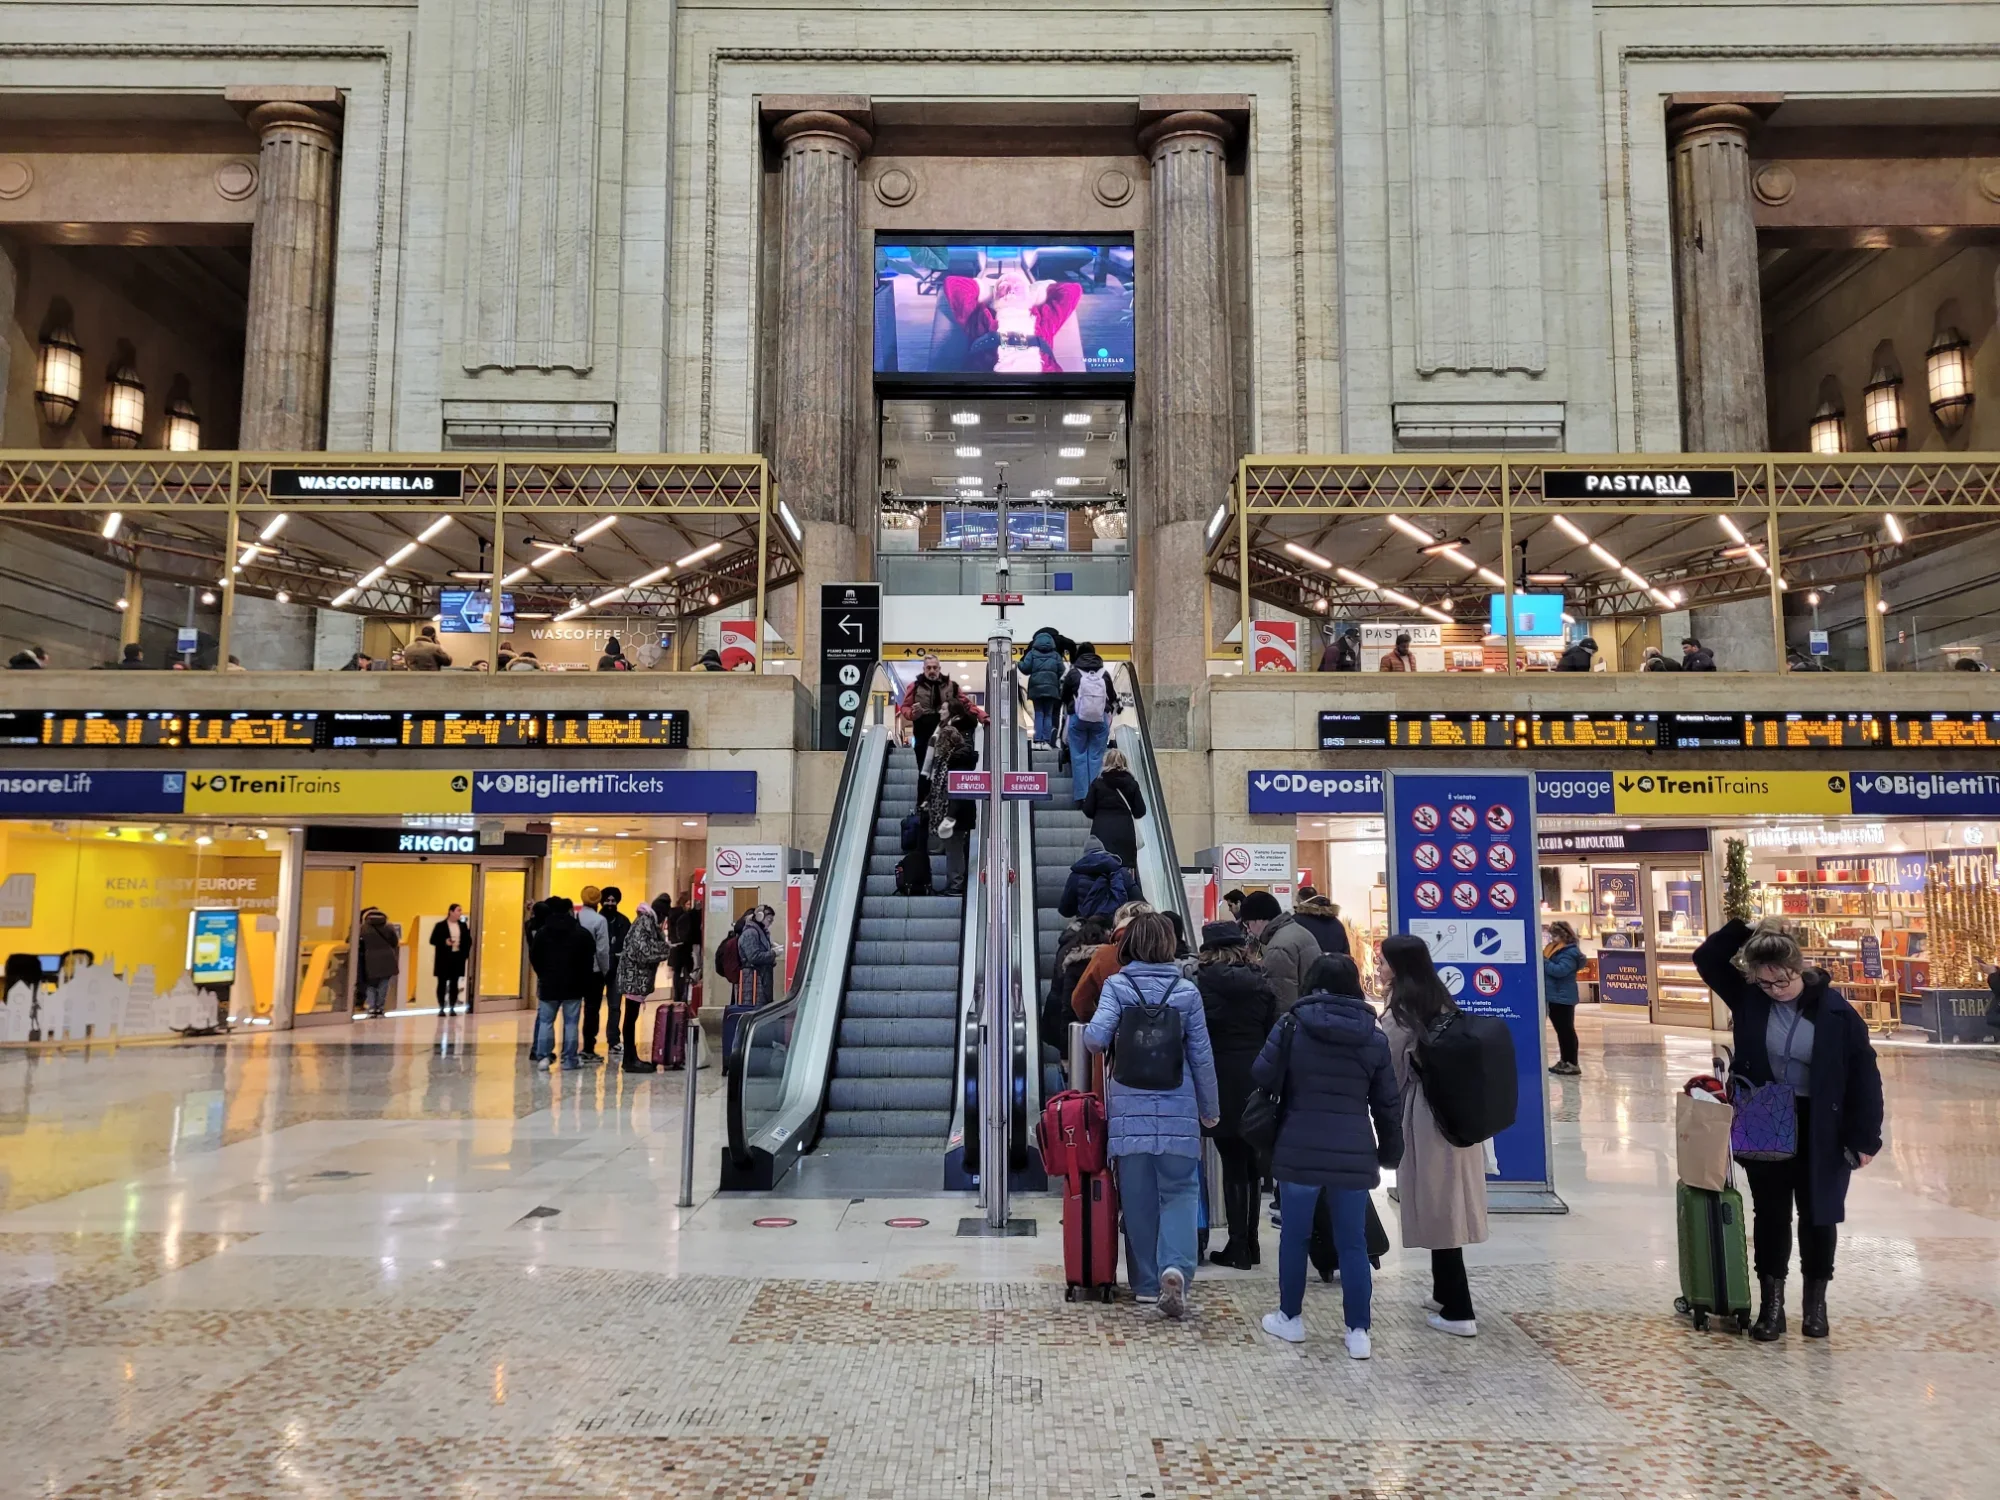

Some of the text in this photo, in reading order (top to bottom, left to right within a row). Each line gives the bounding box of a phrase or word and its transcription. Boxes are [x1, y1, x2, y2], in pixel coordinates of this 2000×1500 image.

[230, 775, 341, 794] Treni Trains
[515, 774, 664, 798] Biglietti Tickets
[1010, 783, 1040, 791] SERVIZIO
[1015, 775, 1035, 783] FUORI
[1292, 774, 1385, 797] Deposit
[1537, 778, 1611, 799] uggage
[1656, 775, 1769, 795] Treni Trains
[1893, 775, 1984, 799] Biglietti
[1453, 793, 1477, 801] vietato
[105, 877, 149, 890] KENA
[198, 878, 257, 891] EUROPE
